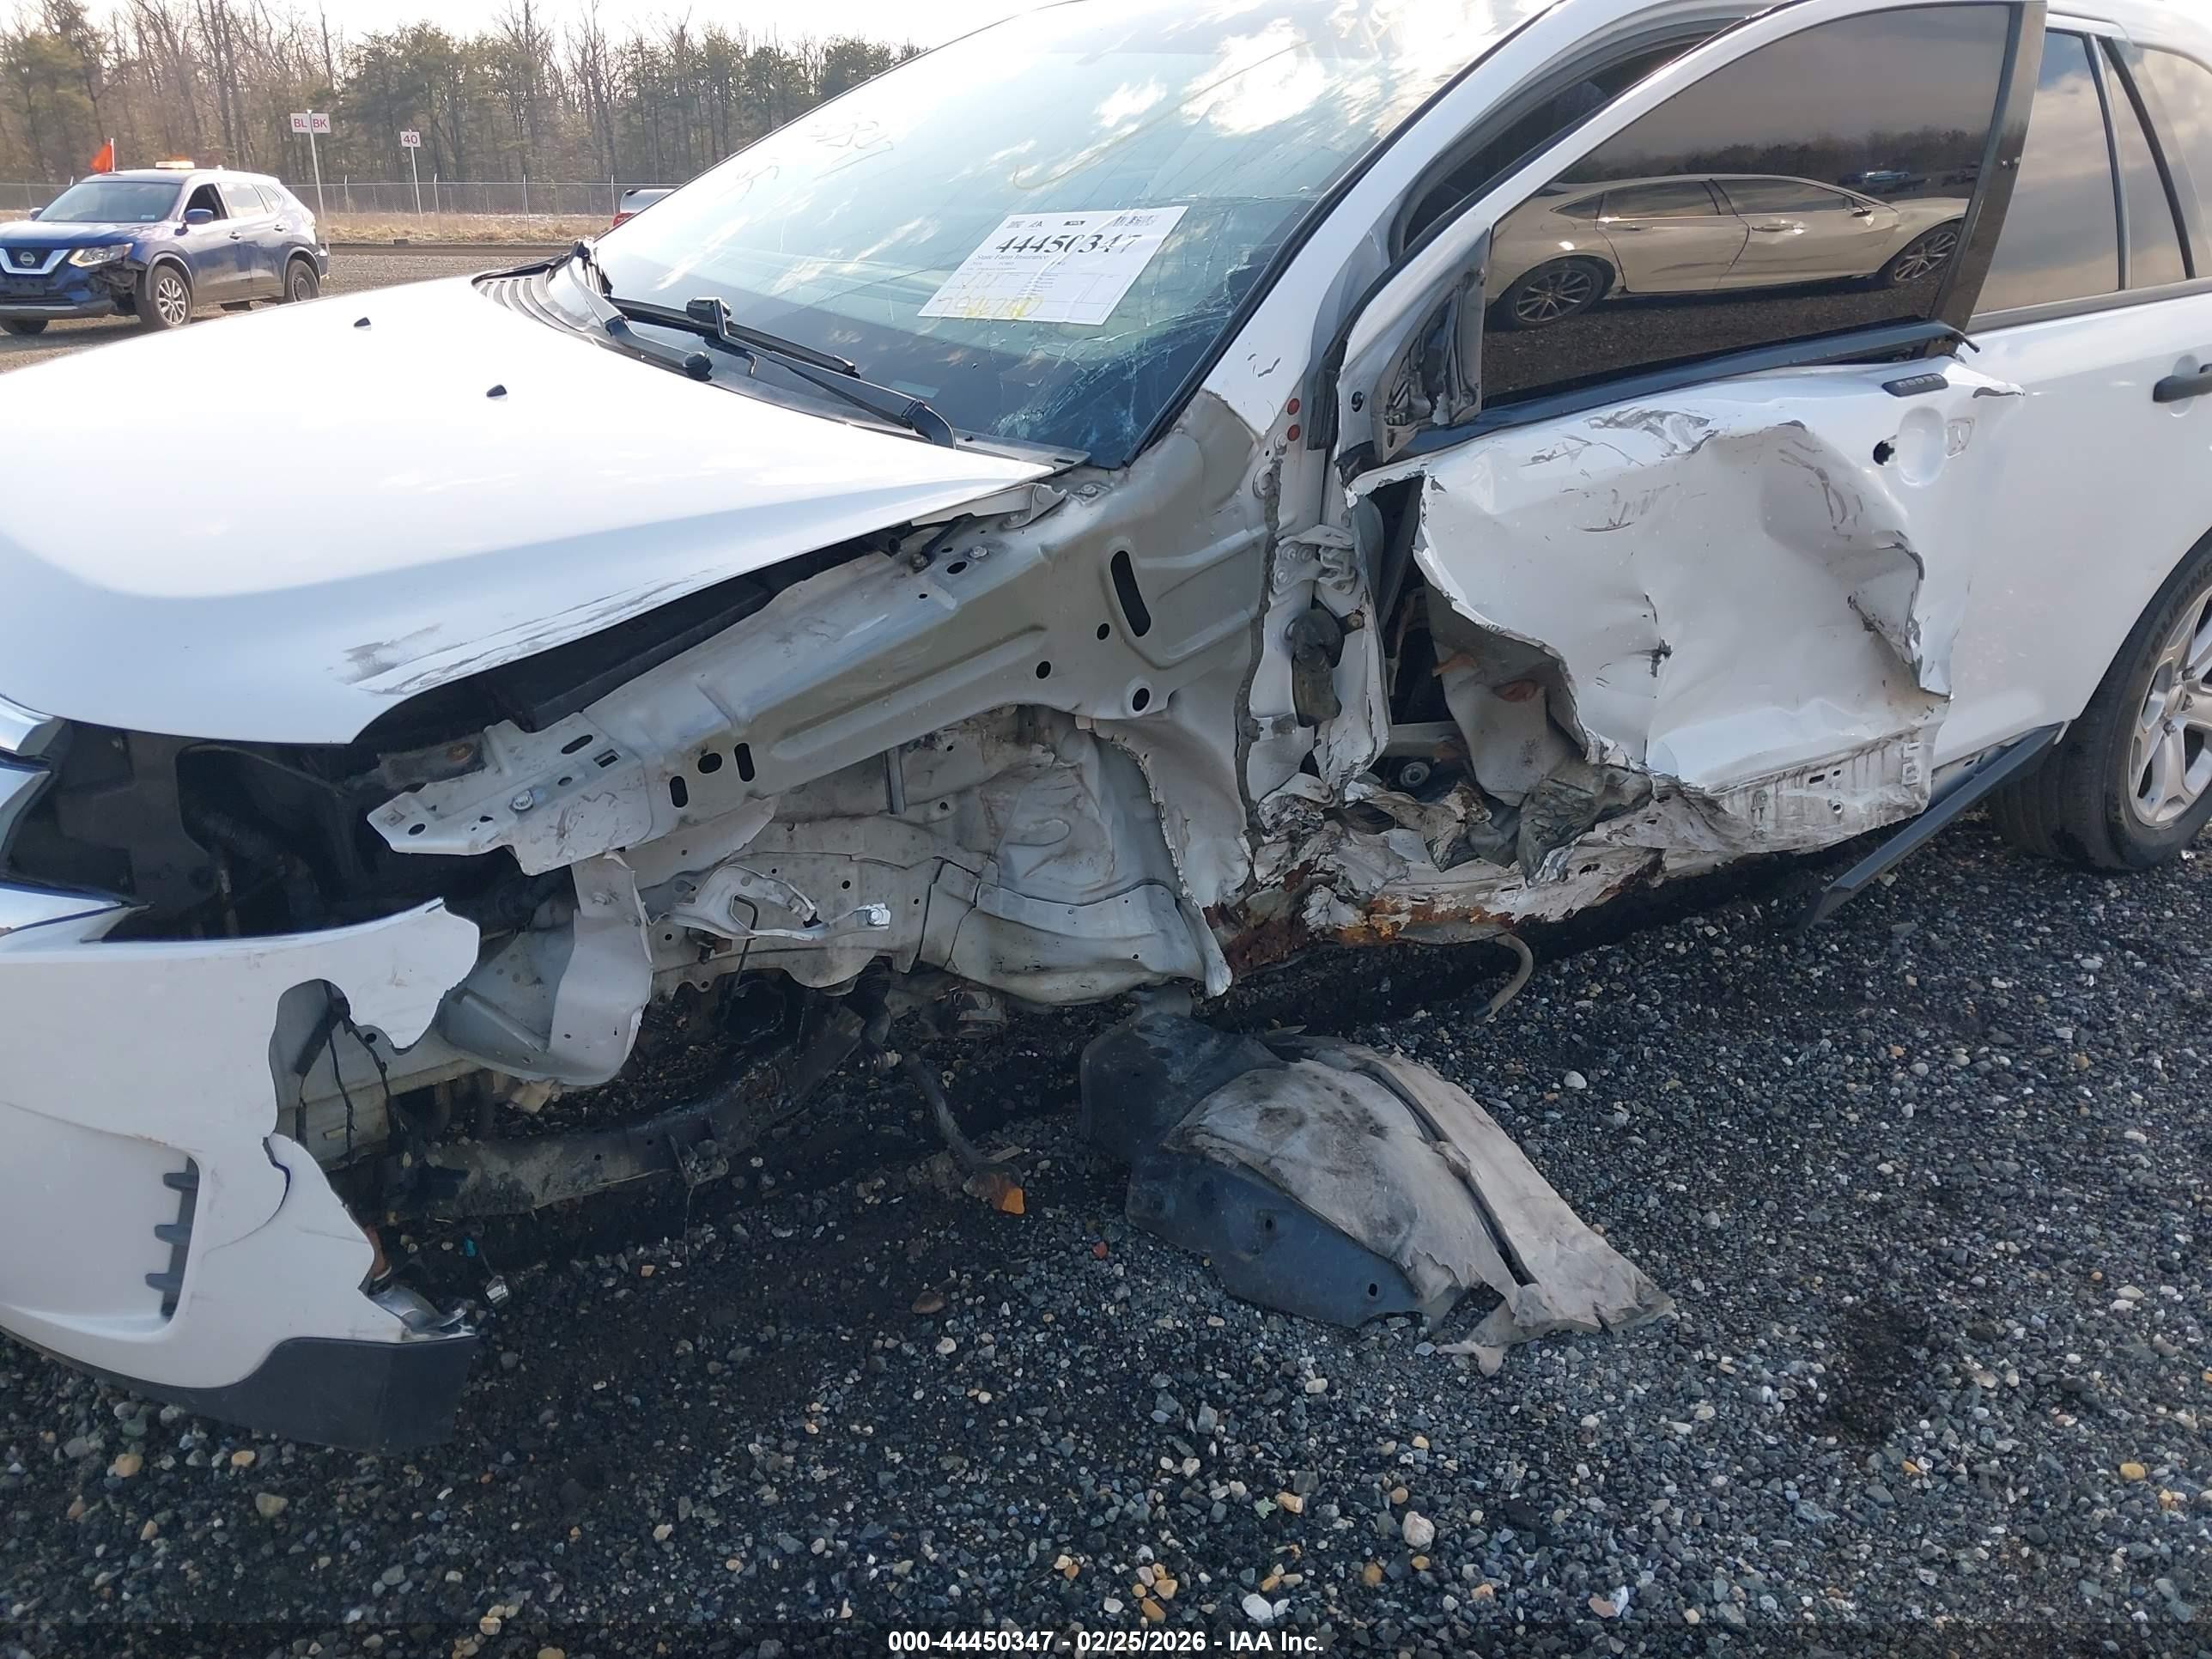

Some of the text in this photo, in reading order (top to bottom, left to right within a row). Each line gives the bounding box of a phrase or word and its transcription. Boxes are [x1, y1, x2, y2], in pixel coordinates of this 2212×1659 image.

[294, 118, 307, 128] BL
[313, 118, 327, 128] BK
[404, 135, 418, 144] 40
